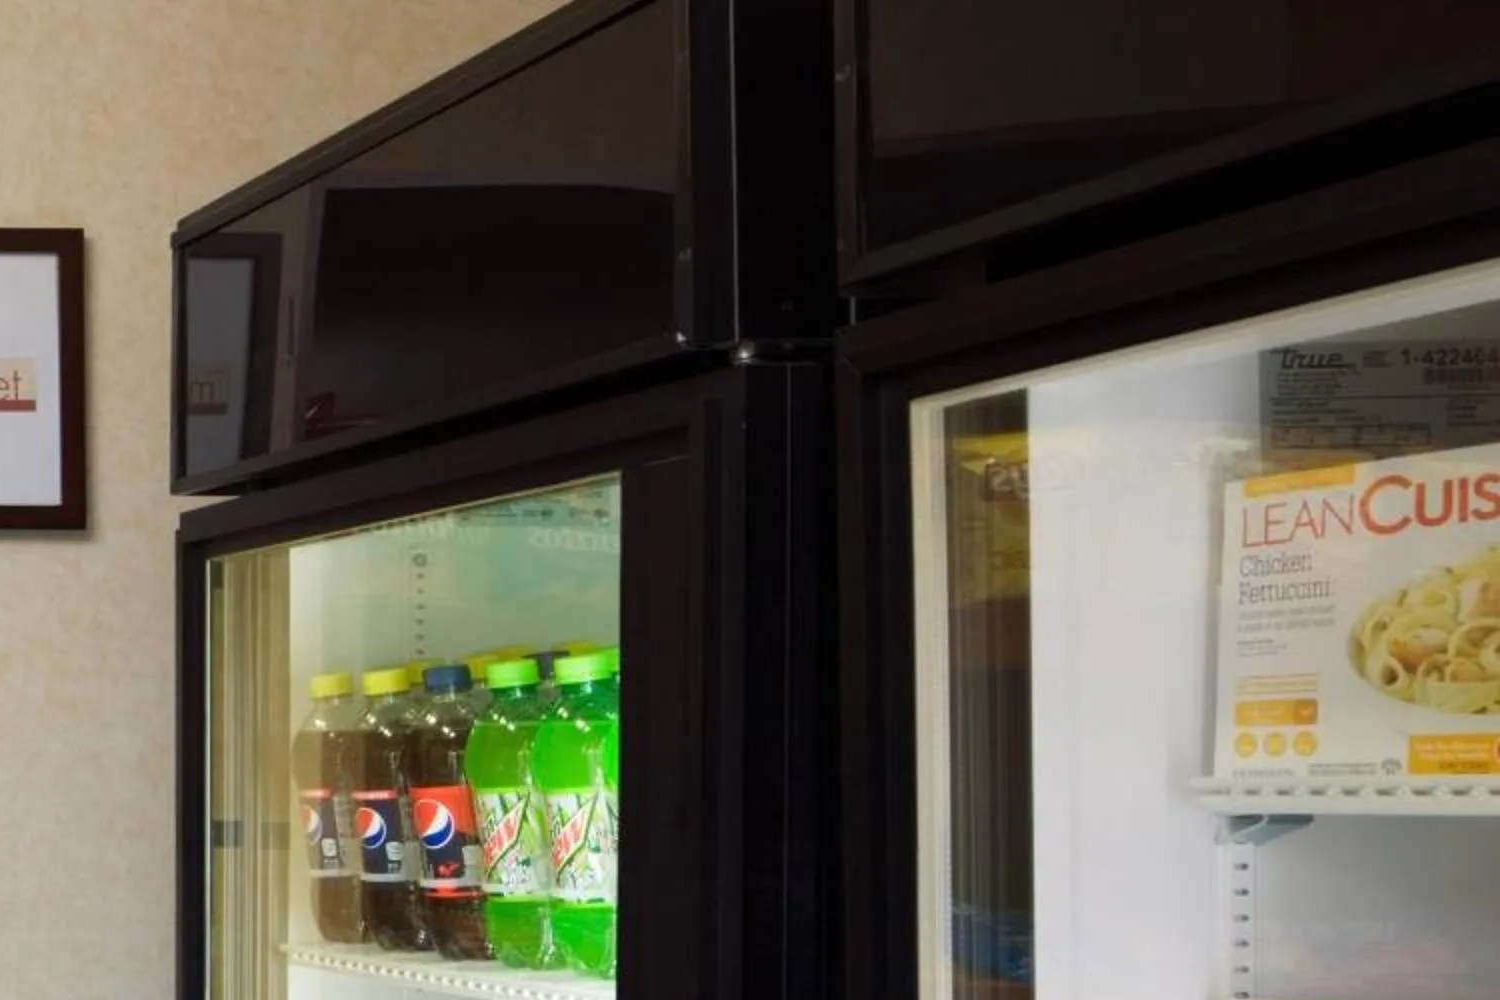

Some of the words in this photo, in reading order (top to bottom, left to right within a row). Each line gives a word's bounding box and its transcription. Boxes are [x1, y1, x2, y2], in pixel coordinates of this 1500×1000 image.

[1243, 495, 1355, 548] LEAN
[1239, 550, 1313, 578] Chicken
[1238, 575, 1331, 605] Fettuccini
